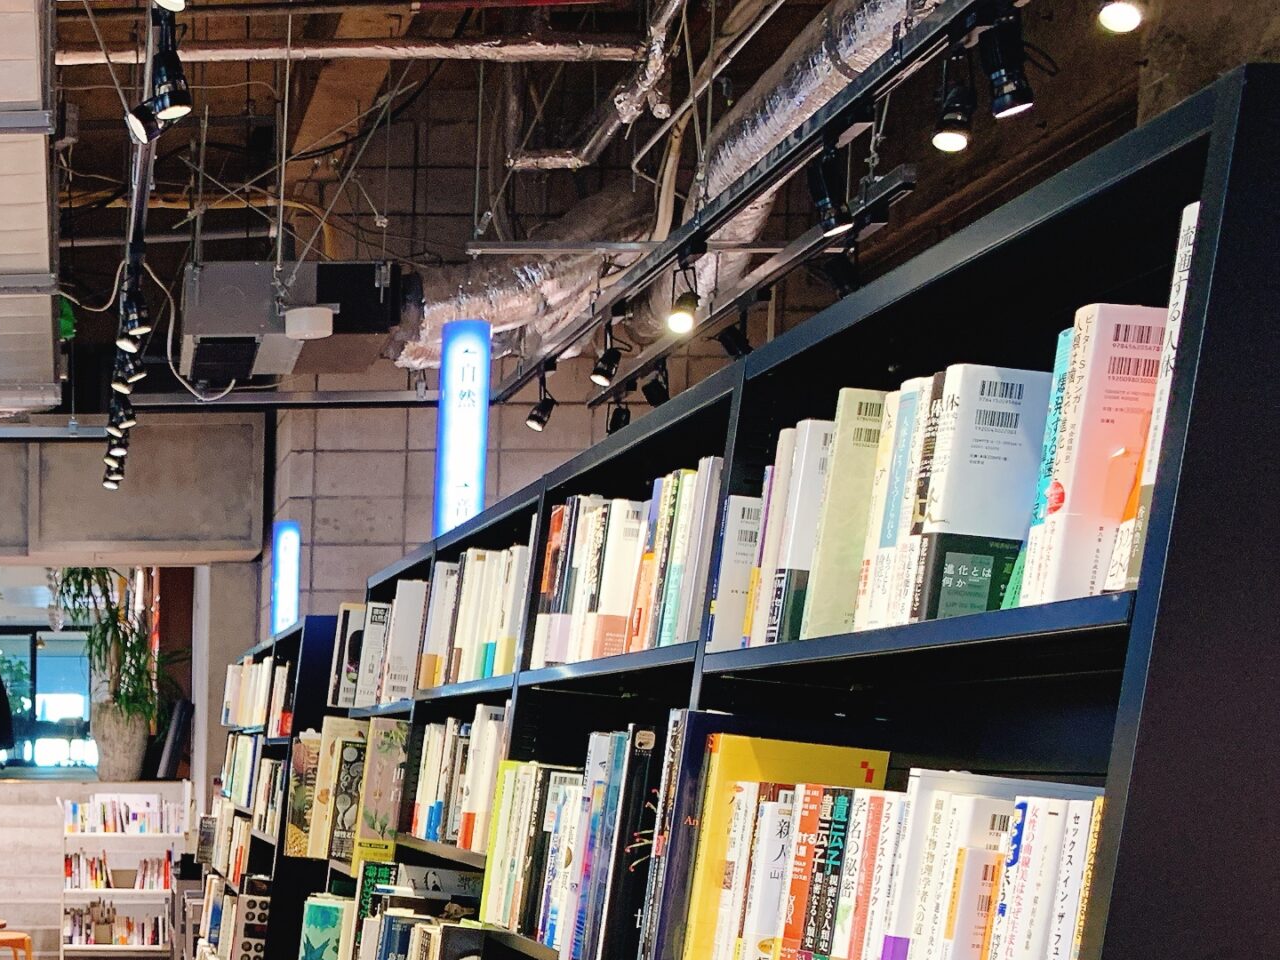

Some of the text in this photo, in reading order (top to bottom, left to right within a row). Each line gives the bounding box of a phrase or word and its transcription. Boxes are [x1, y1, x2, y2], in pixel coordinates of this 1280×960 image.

[942, 575, 967, 588] 何か
[943, 563, 993, 578] 進化とは
[824, 793, 850, 876] 遺伝子
[841, 796, 868, 899] 学名の秘密
[871, 800, 894, 907] フランシス・クリック
